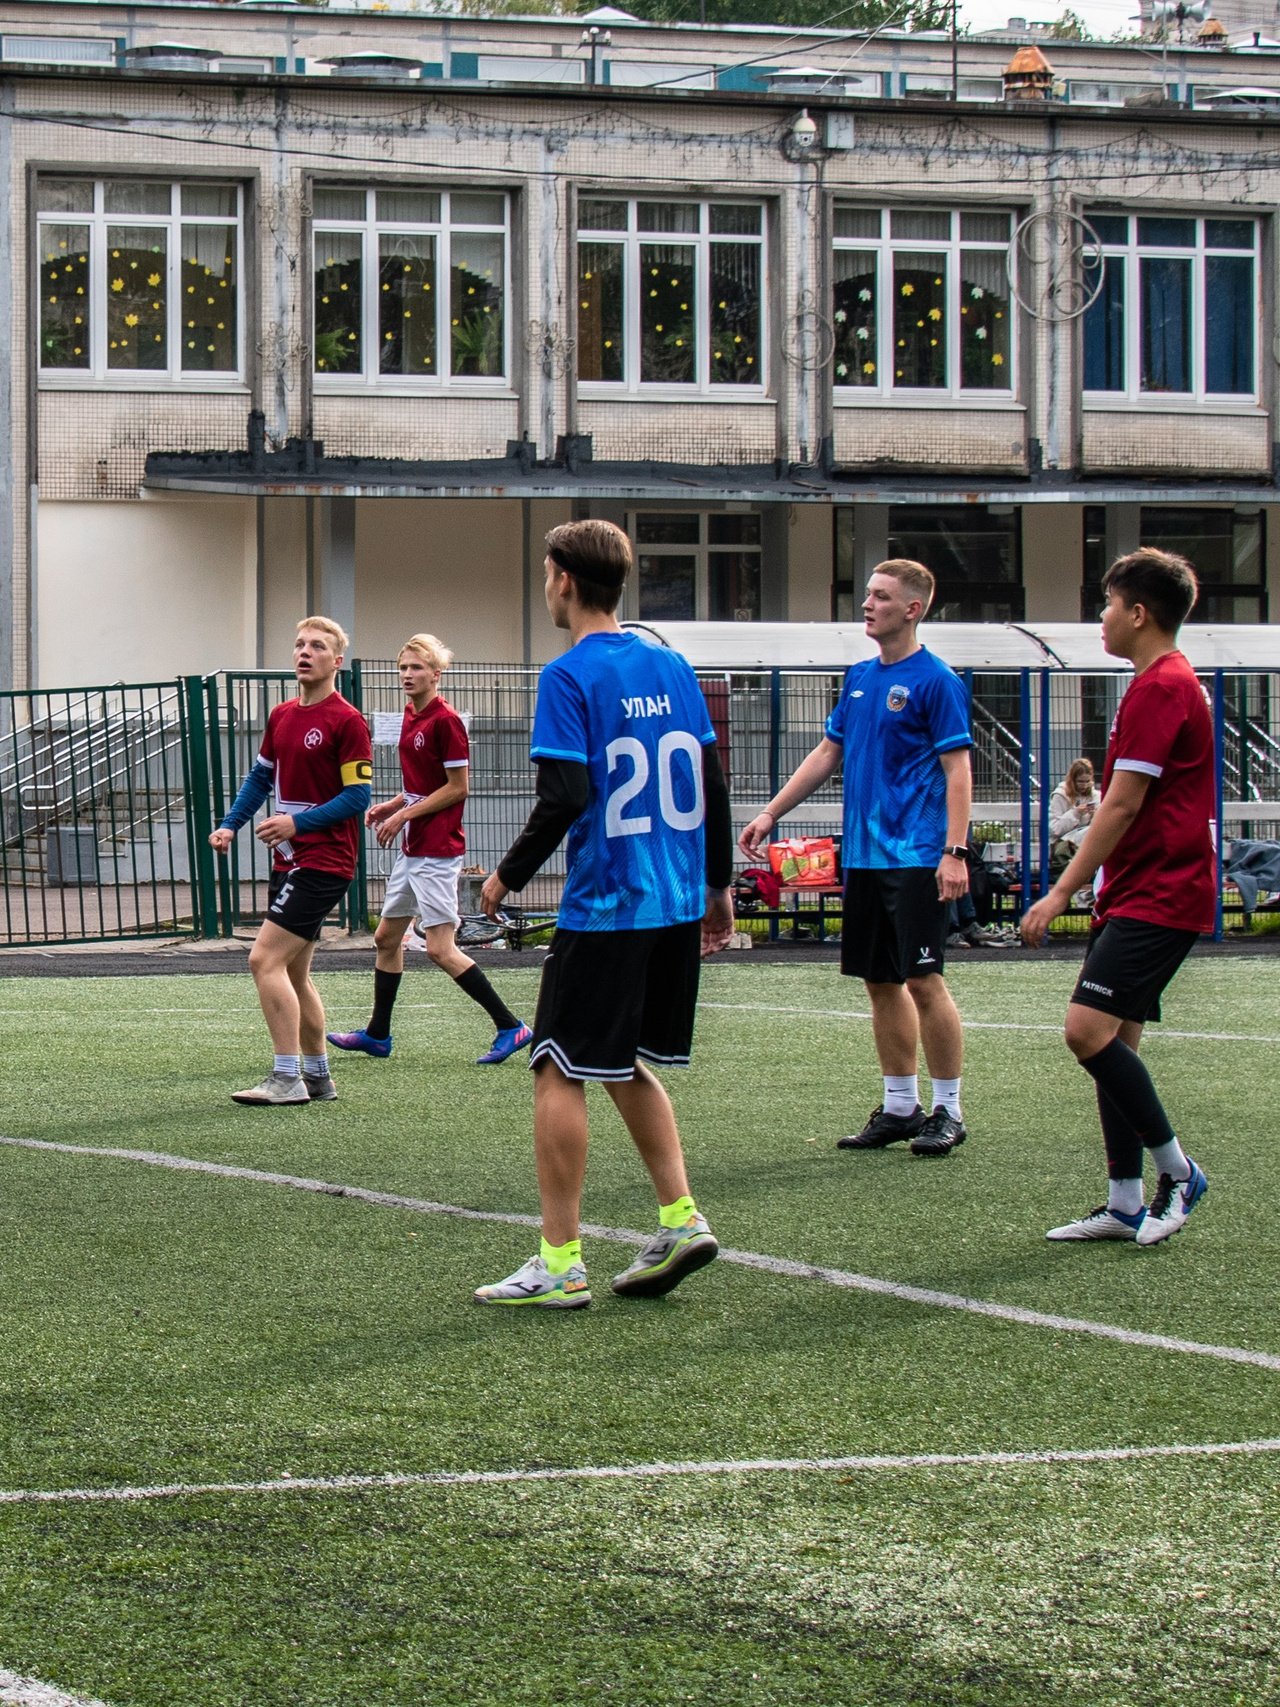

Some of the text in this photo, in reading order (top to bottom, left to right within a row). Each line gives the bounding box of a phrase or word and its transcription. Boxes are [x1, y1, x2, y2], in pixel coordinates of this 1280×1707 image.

[621, 694, 671, 718] УЛАН
[605, 730, 705, 838] 20
[275, 882, 295, 906] 5
[1081, 980, 1114, 997] PATRICK
